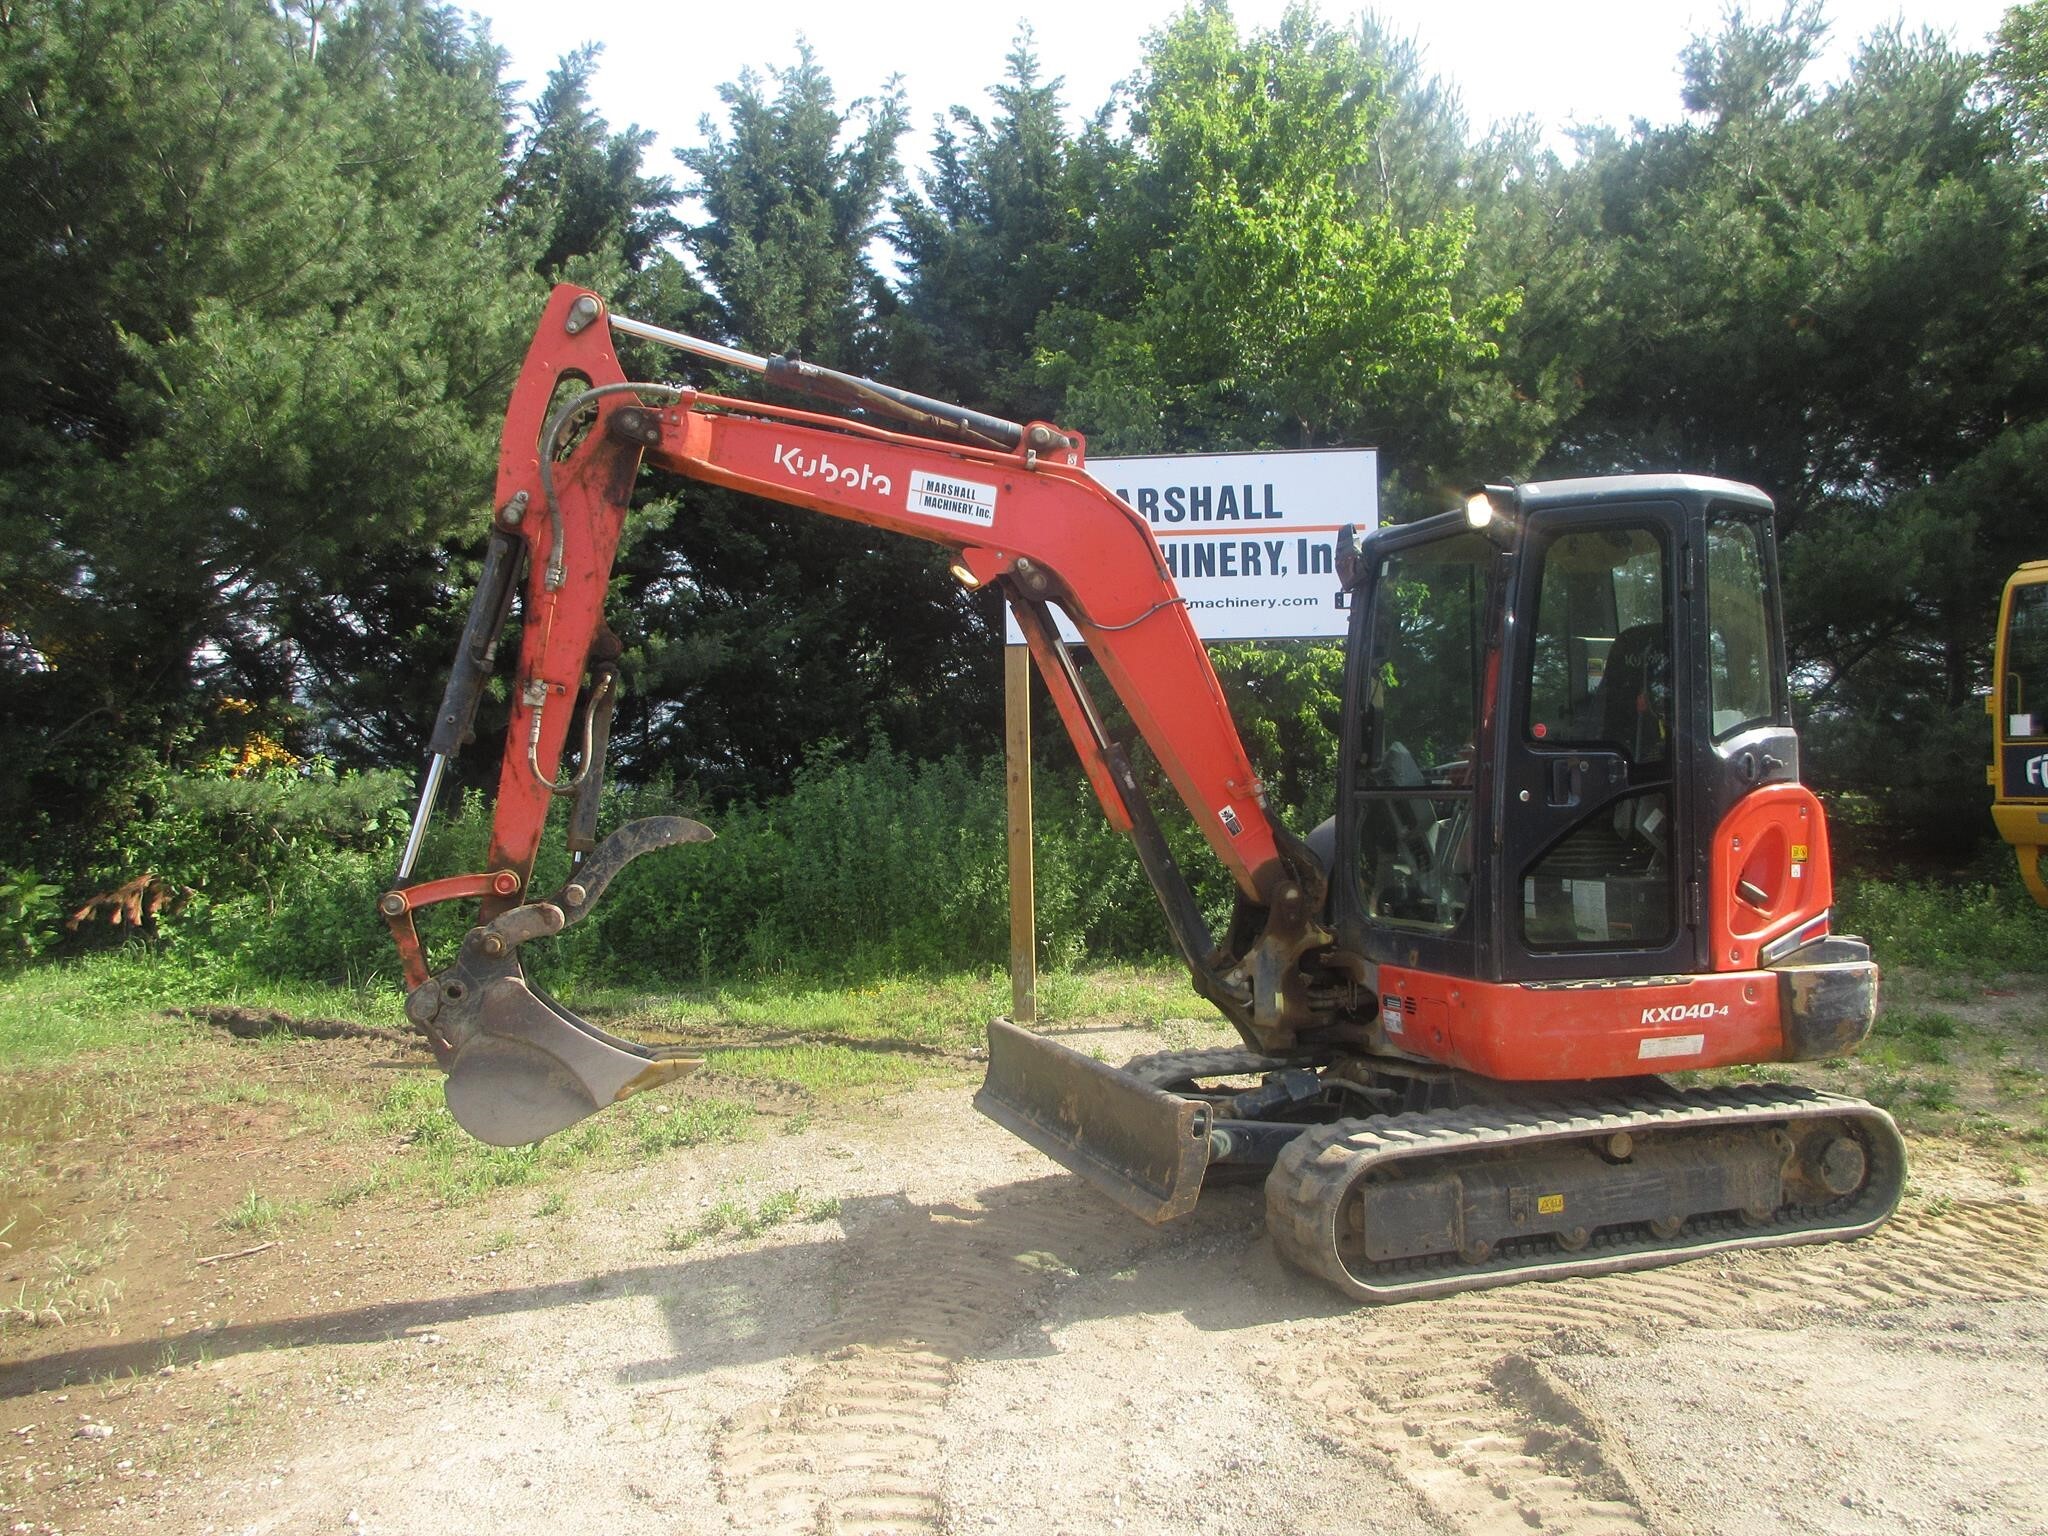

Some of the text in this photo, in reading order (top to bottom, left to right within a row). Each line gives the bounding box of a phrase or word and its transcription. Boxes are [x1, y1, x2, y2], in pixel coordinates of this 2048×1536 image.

[774, 443, 892, 496] Kubota
[926, 480, 976, 500] MARSHALL
[975, 505, 992, 519] Inc.
[1641, 1003, 1729, 1024] KX040-4
